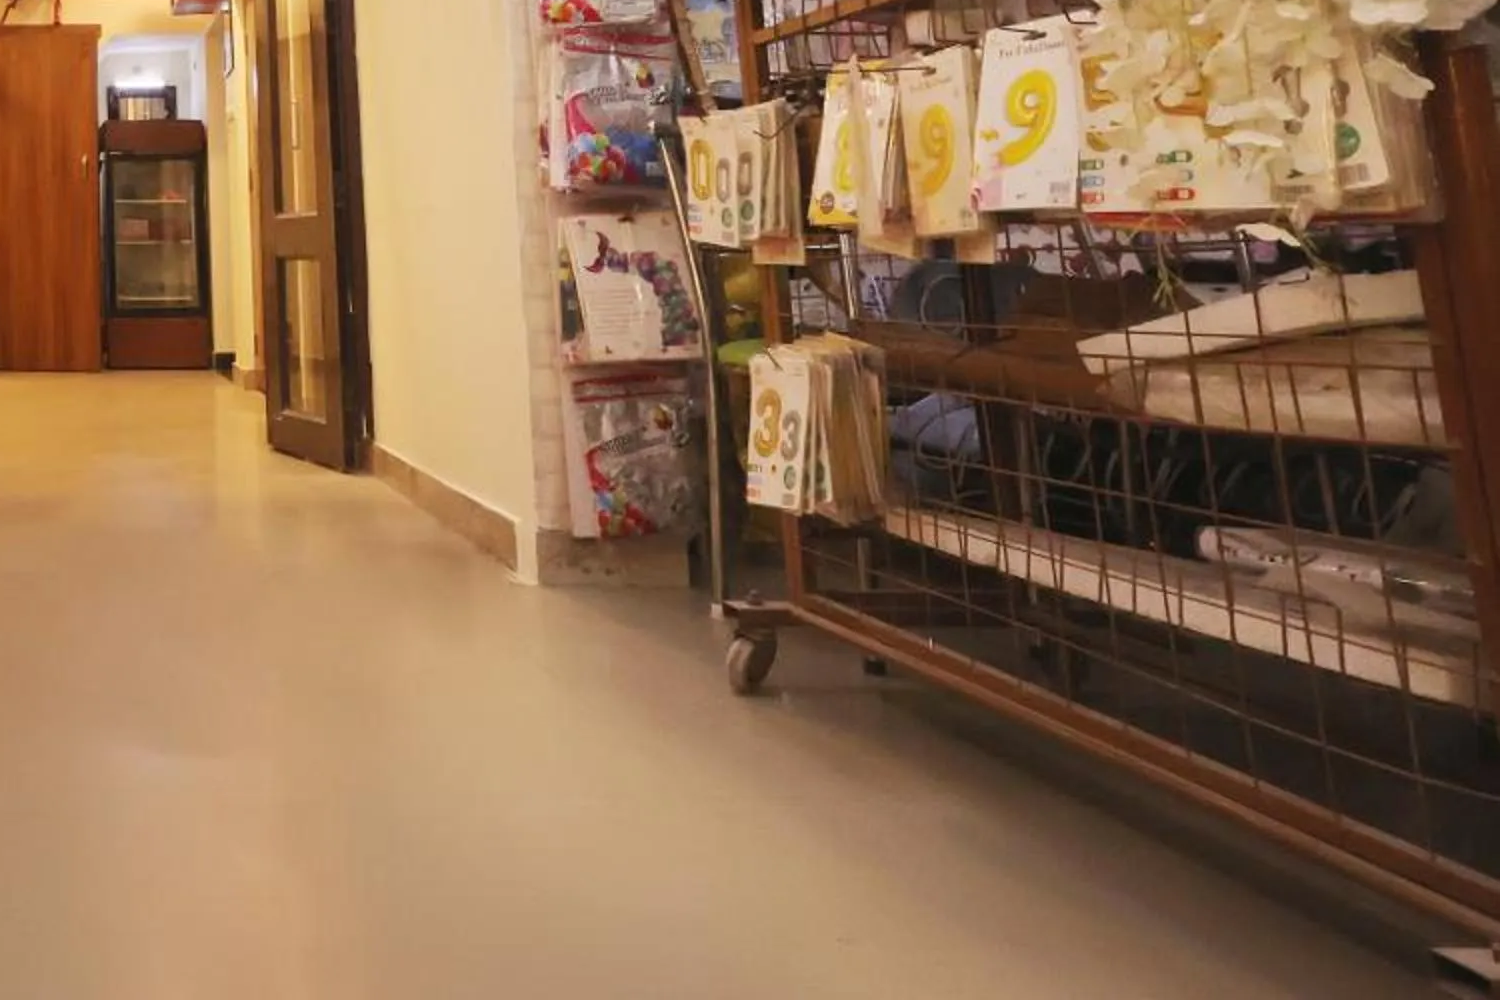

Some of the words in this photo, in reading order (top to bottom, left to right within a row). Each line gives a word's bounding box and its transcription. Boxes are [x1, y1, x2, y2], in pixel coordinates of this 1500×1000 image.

[920, 103, 957, 197] 9
[1001, 69, 1057, 167] 9
[754, 387, 783, 457] 3
